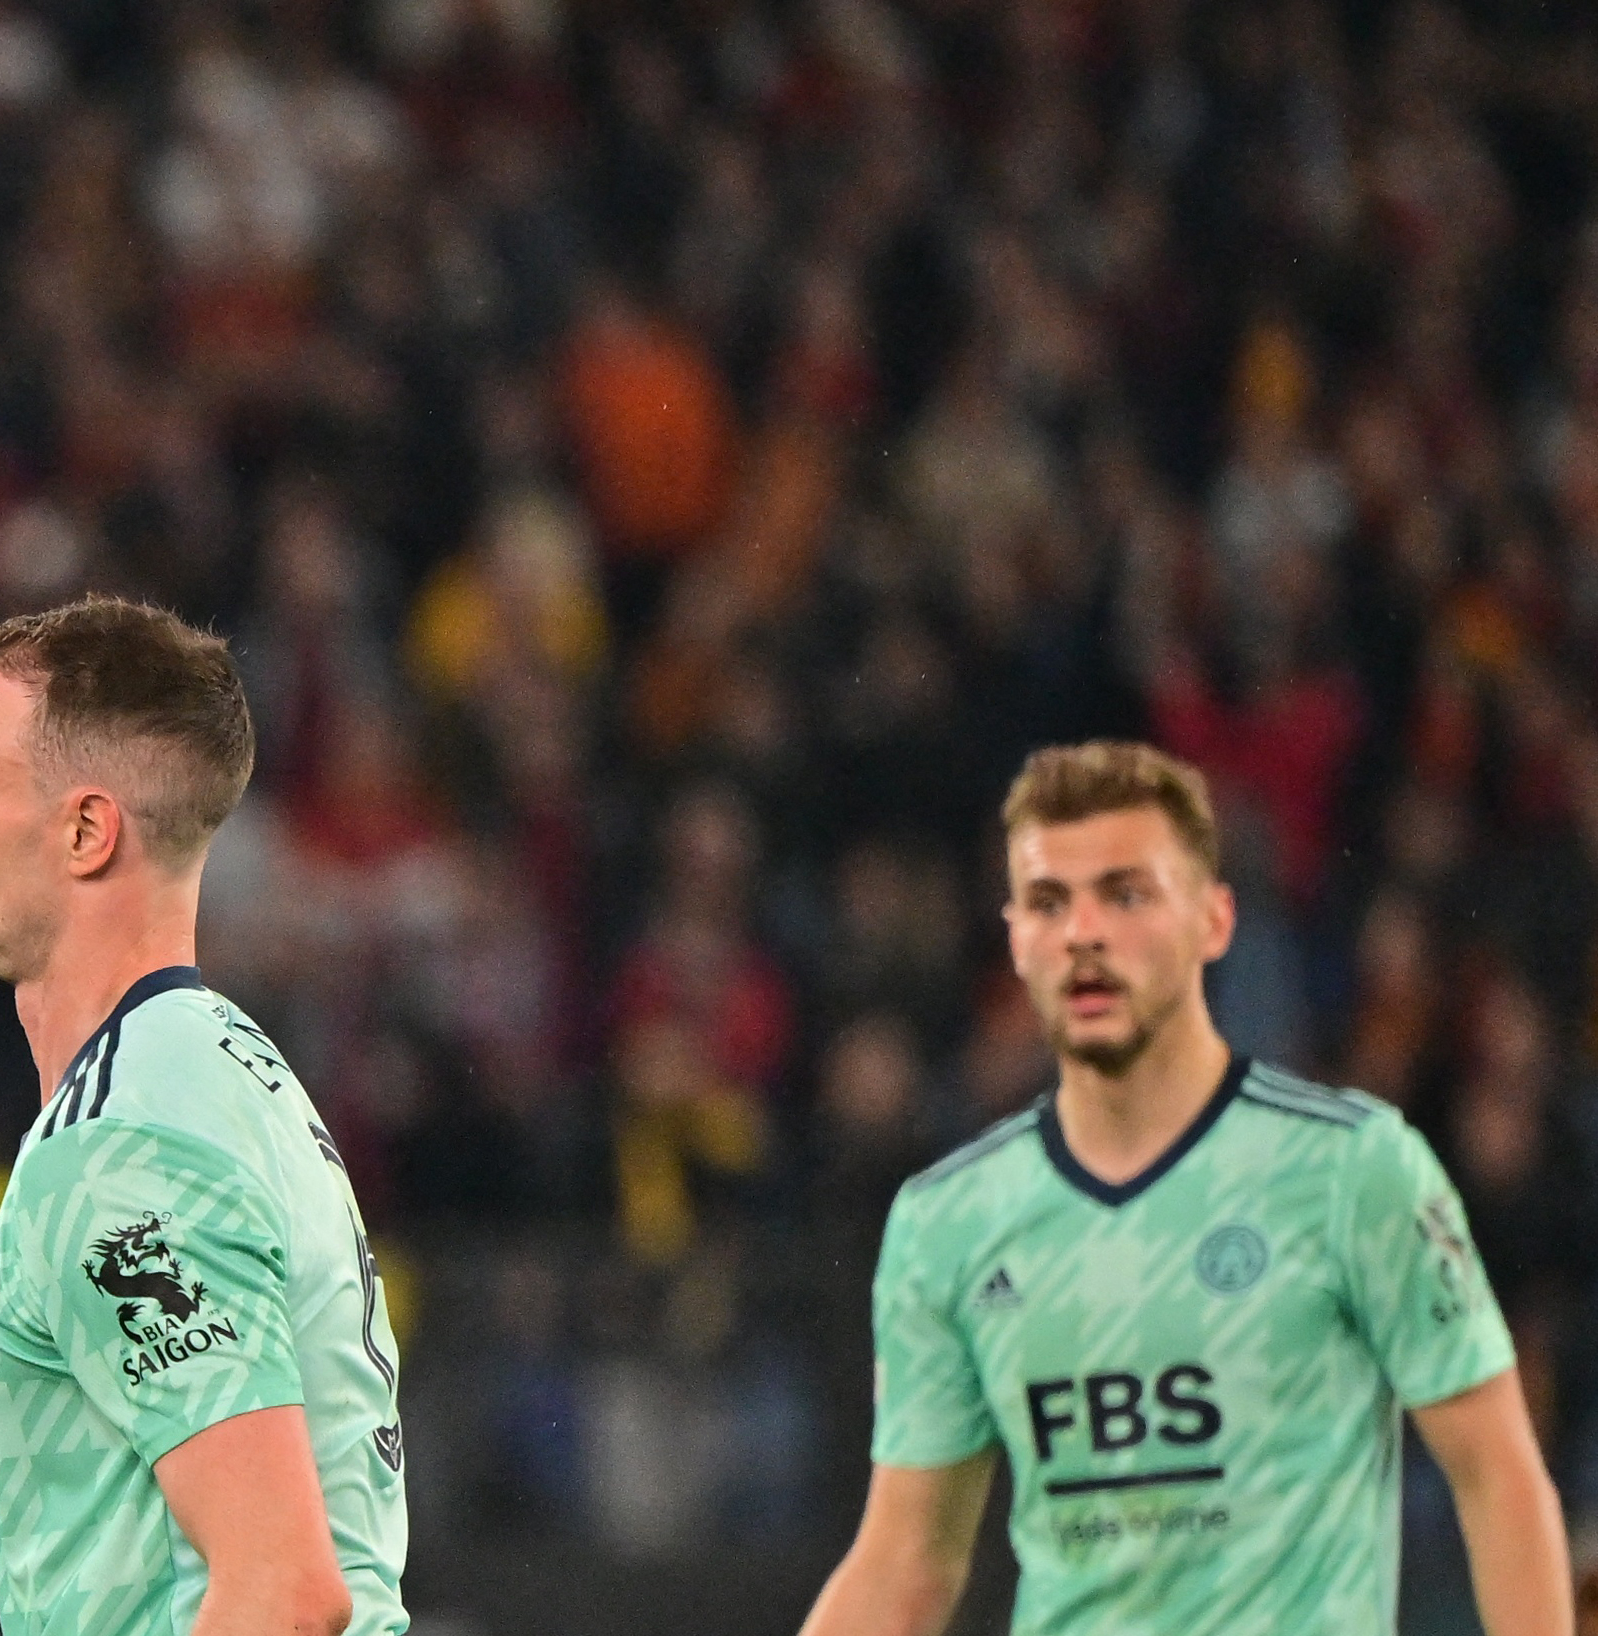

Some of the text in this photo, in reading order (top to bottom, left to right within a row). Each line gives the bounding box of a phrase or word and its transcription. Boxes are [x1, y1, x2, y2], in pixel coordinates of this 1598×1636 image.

[122, 1316, 239, 1387] SAIGON
[141, 1316, 182, 1342] BIA
[1025, 1362, 1222, 1461] FBS
